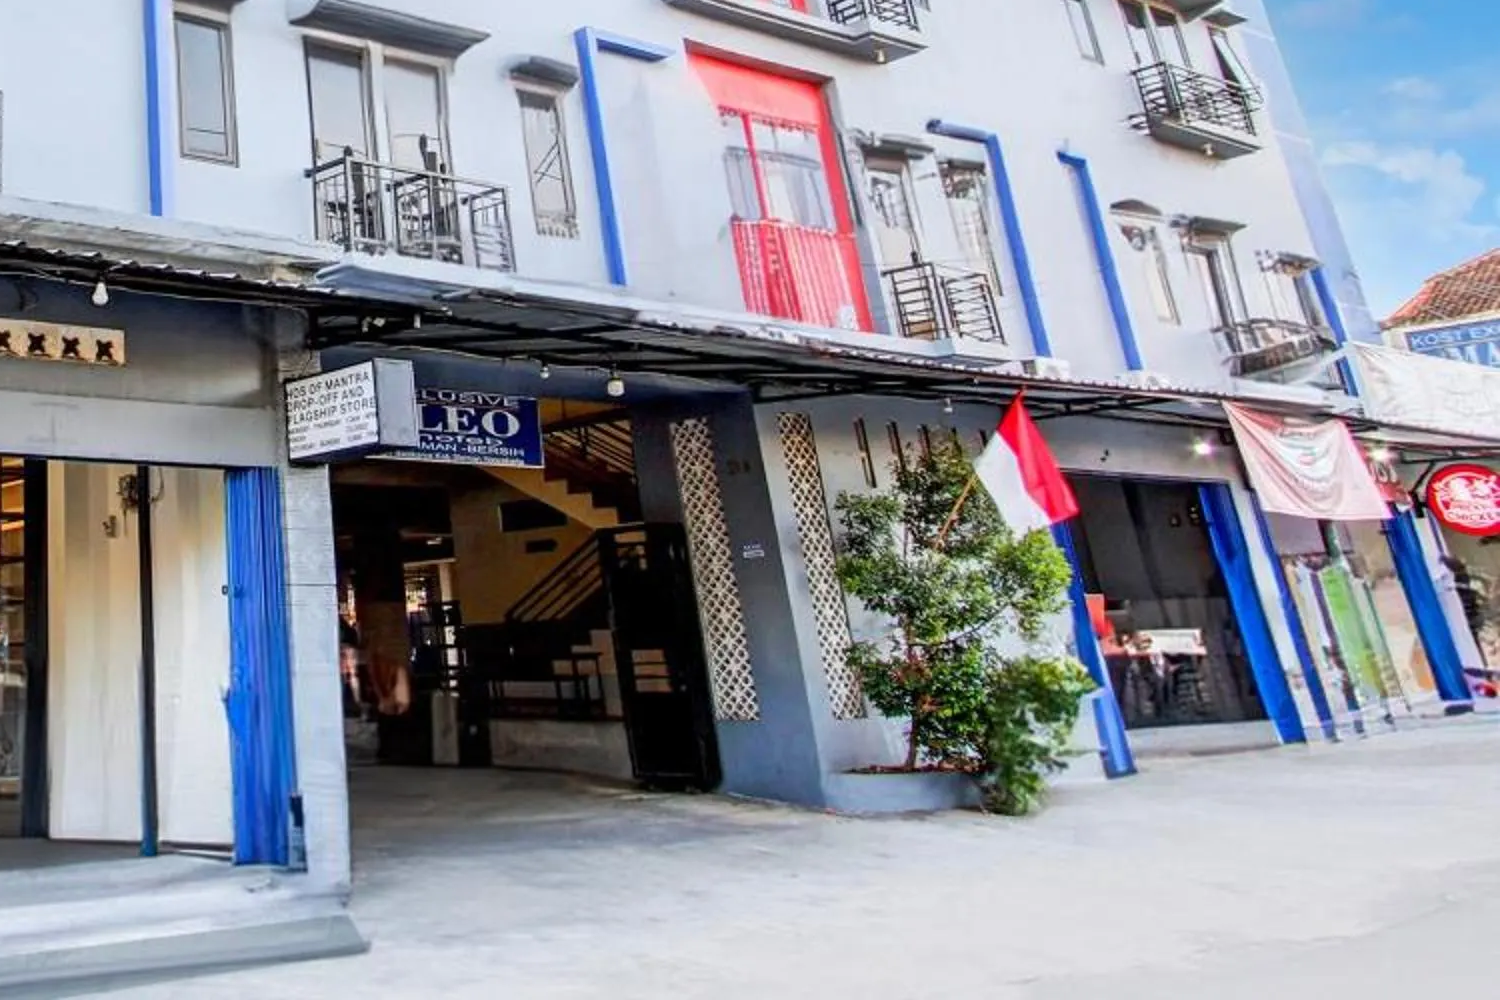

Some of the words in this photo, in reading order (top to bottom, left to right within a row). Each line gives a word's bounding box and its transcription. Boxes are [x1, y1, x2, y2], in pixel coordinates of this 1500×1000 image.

[309, 381, 322, 395] OF
[325, 371, 370, 390] MANTRA
[340, 396, 376, 415] STORE
[418, 404, 521, 438] LEO
